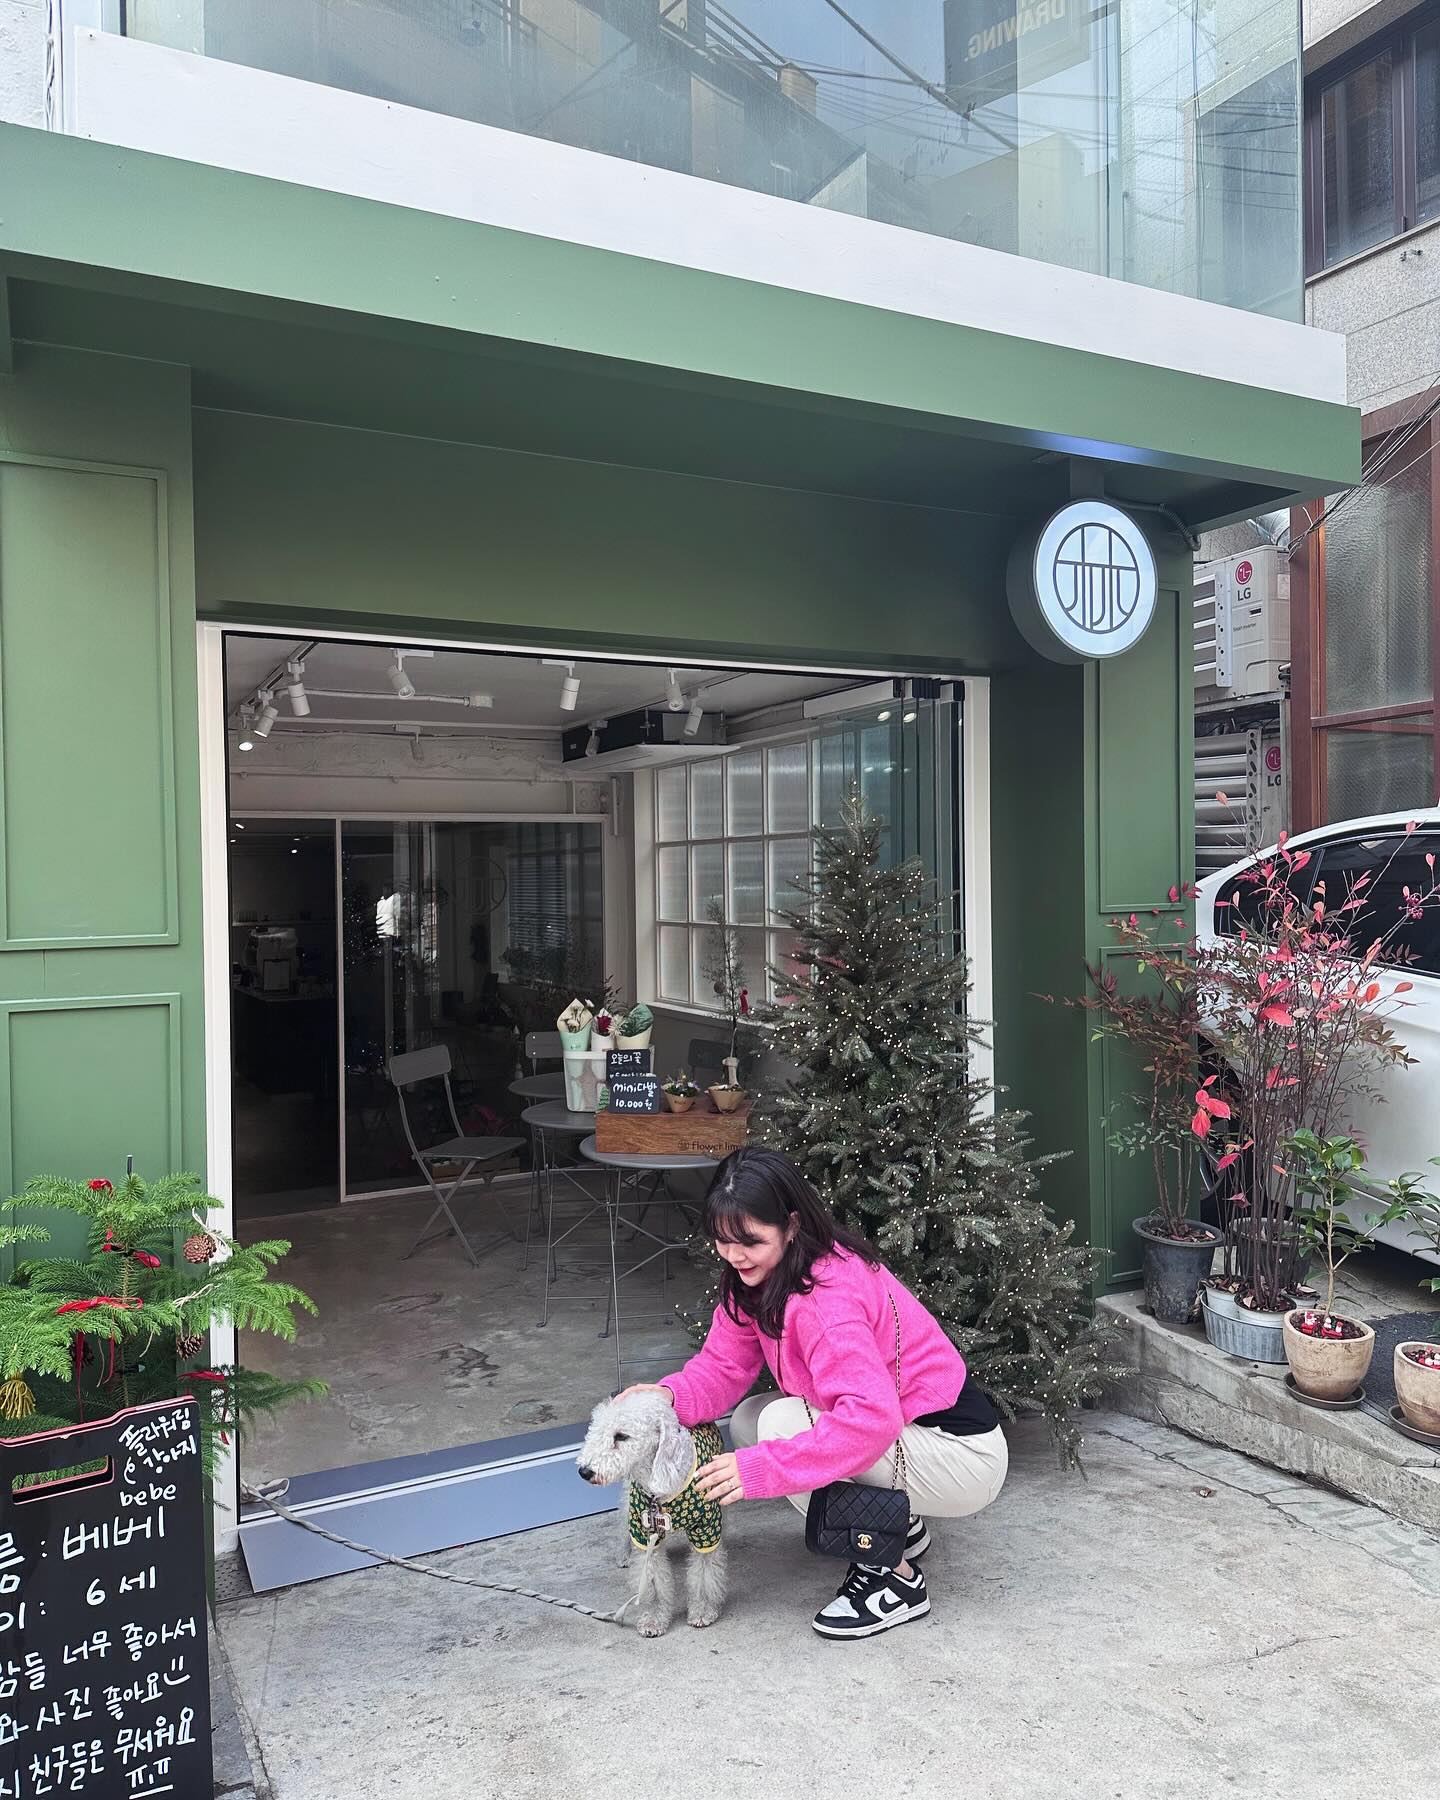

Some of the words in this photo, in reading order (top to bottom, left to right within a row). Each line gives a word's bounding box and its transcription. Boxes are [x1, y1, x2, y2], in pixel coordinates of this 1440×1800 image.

[1237, 587, 1251, 601] LG
[611, 1053, 632, 1065] 오늘의
[120, 1483, 177, 1507] bebe
[86, 1578, 106, 1606] 6
[118, 1565, 156, 1594] 세
[62, 1630, 112, 1665] 너무
[121, 1616, 197, 1662] 좋아서
[36, 1686, 93, 1732] 사진
[102, 1672, 164, 1721] 좋아요
[28, 1739, 105, 1795] 친구들은
[113, 1706, 196, 1765] 무서워요
